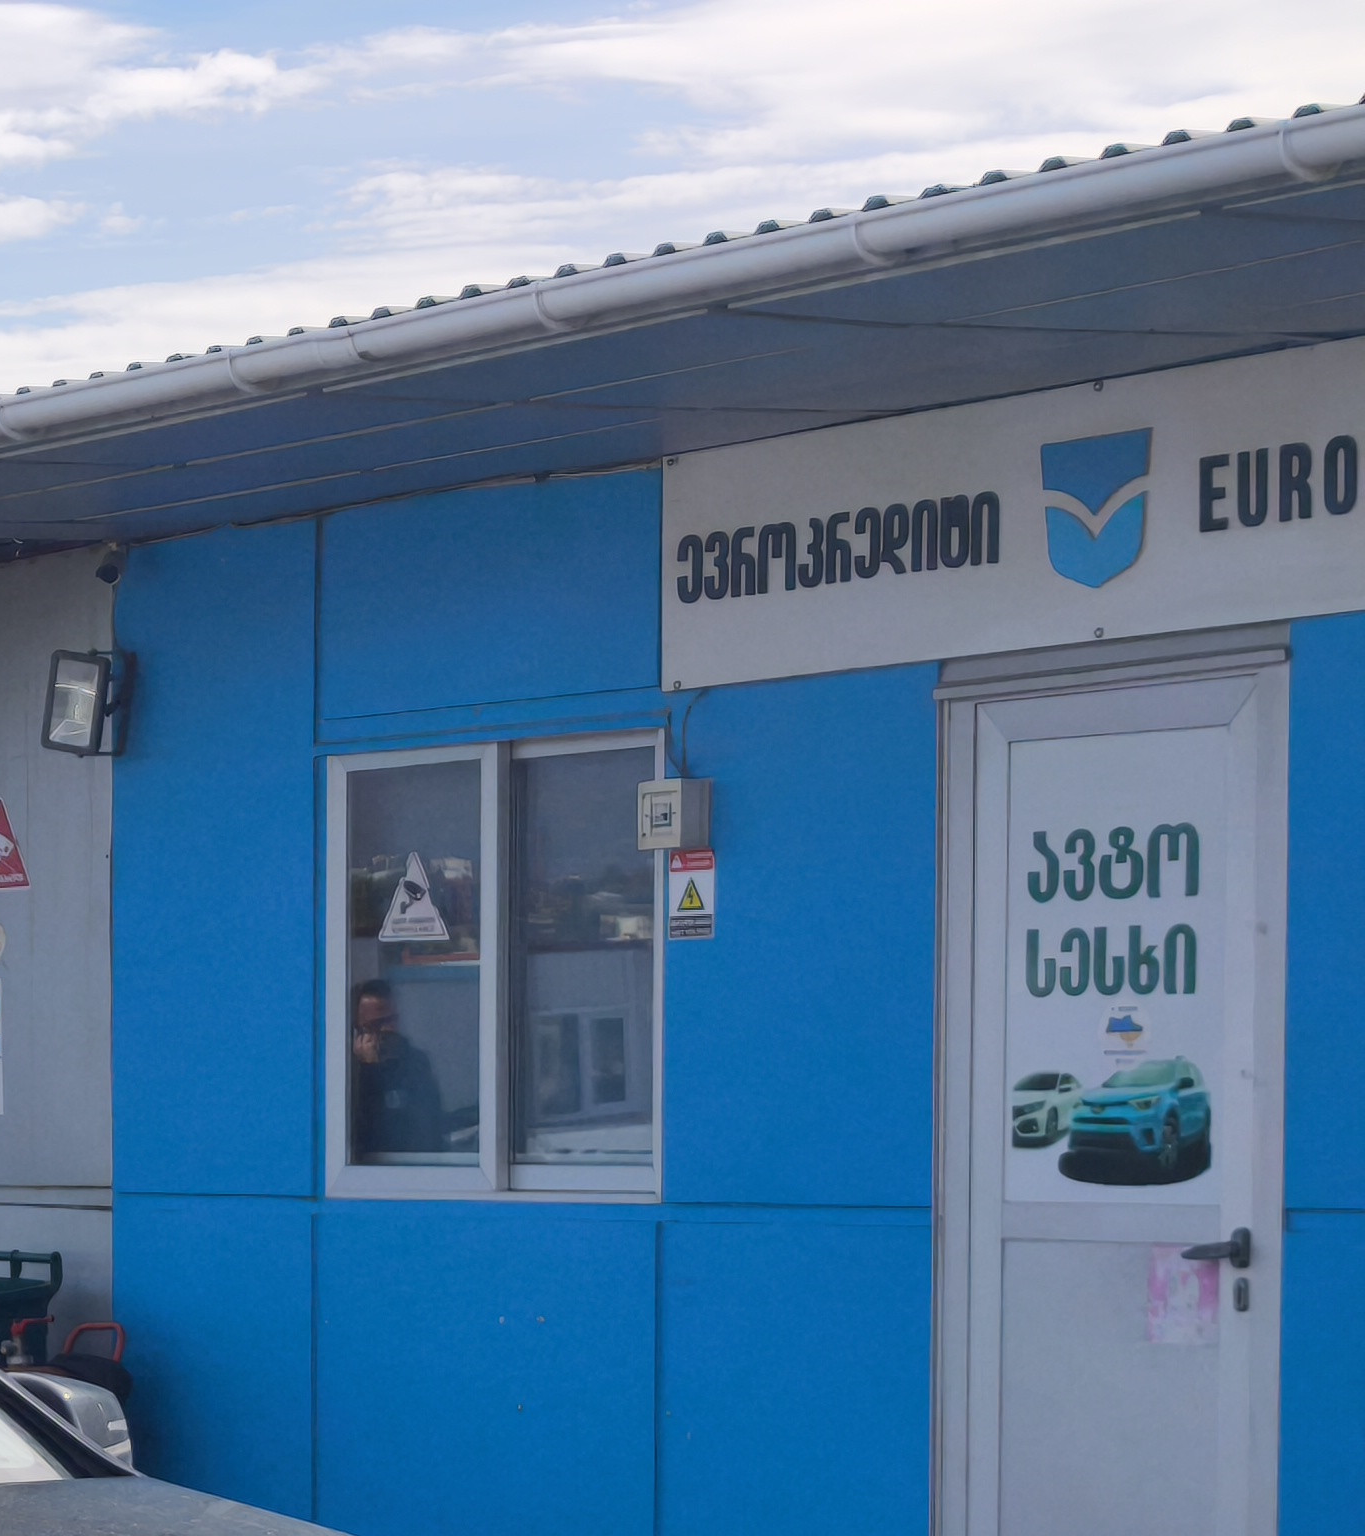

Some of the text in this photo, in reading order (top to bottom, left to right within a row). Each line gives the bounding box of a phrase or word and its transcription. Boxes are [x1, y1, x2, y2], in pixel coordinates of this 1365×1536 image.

[1198, 434, 1359, 533] EURO
[676, 490, 1000, 605] ევროკრედიტი
[1027, 821, 1201, 904] ავტო
[1025, 923, 1199, 998] სესხი
